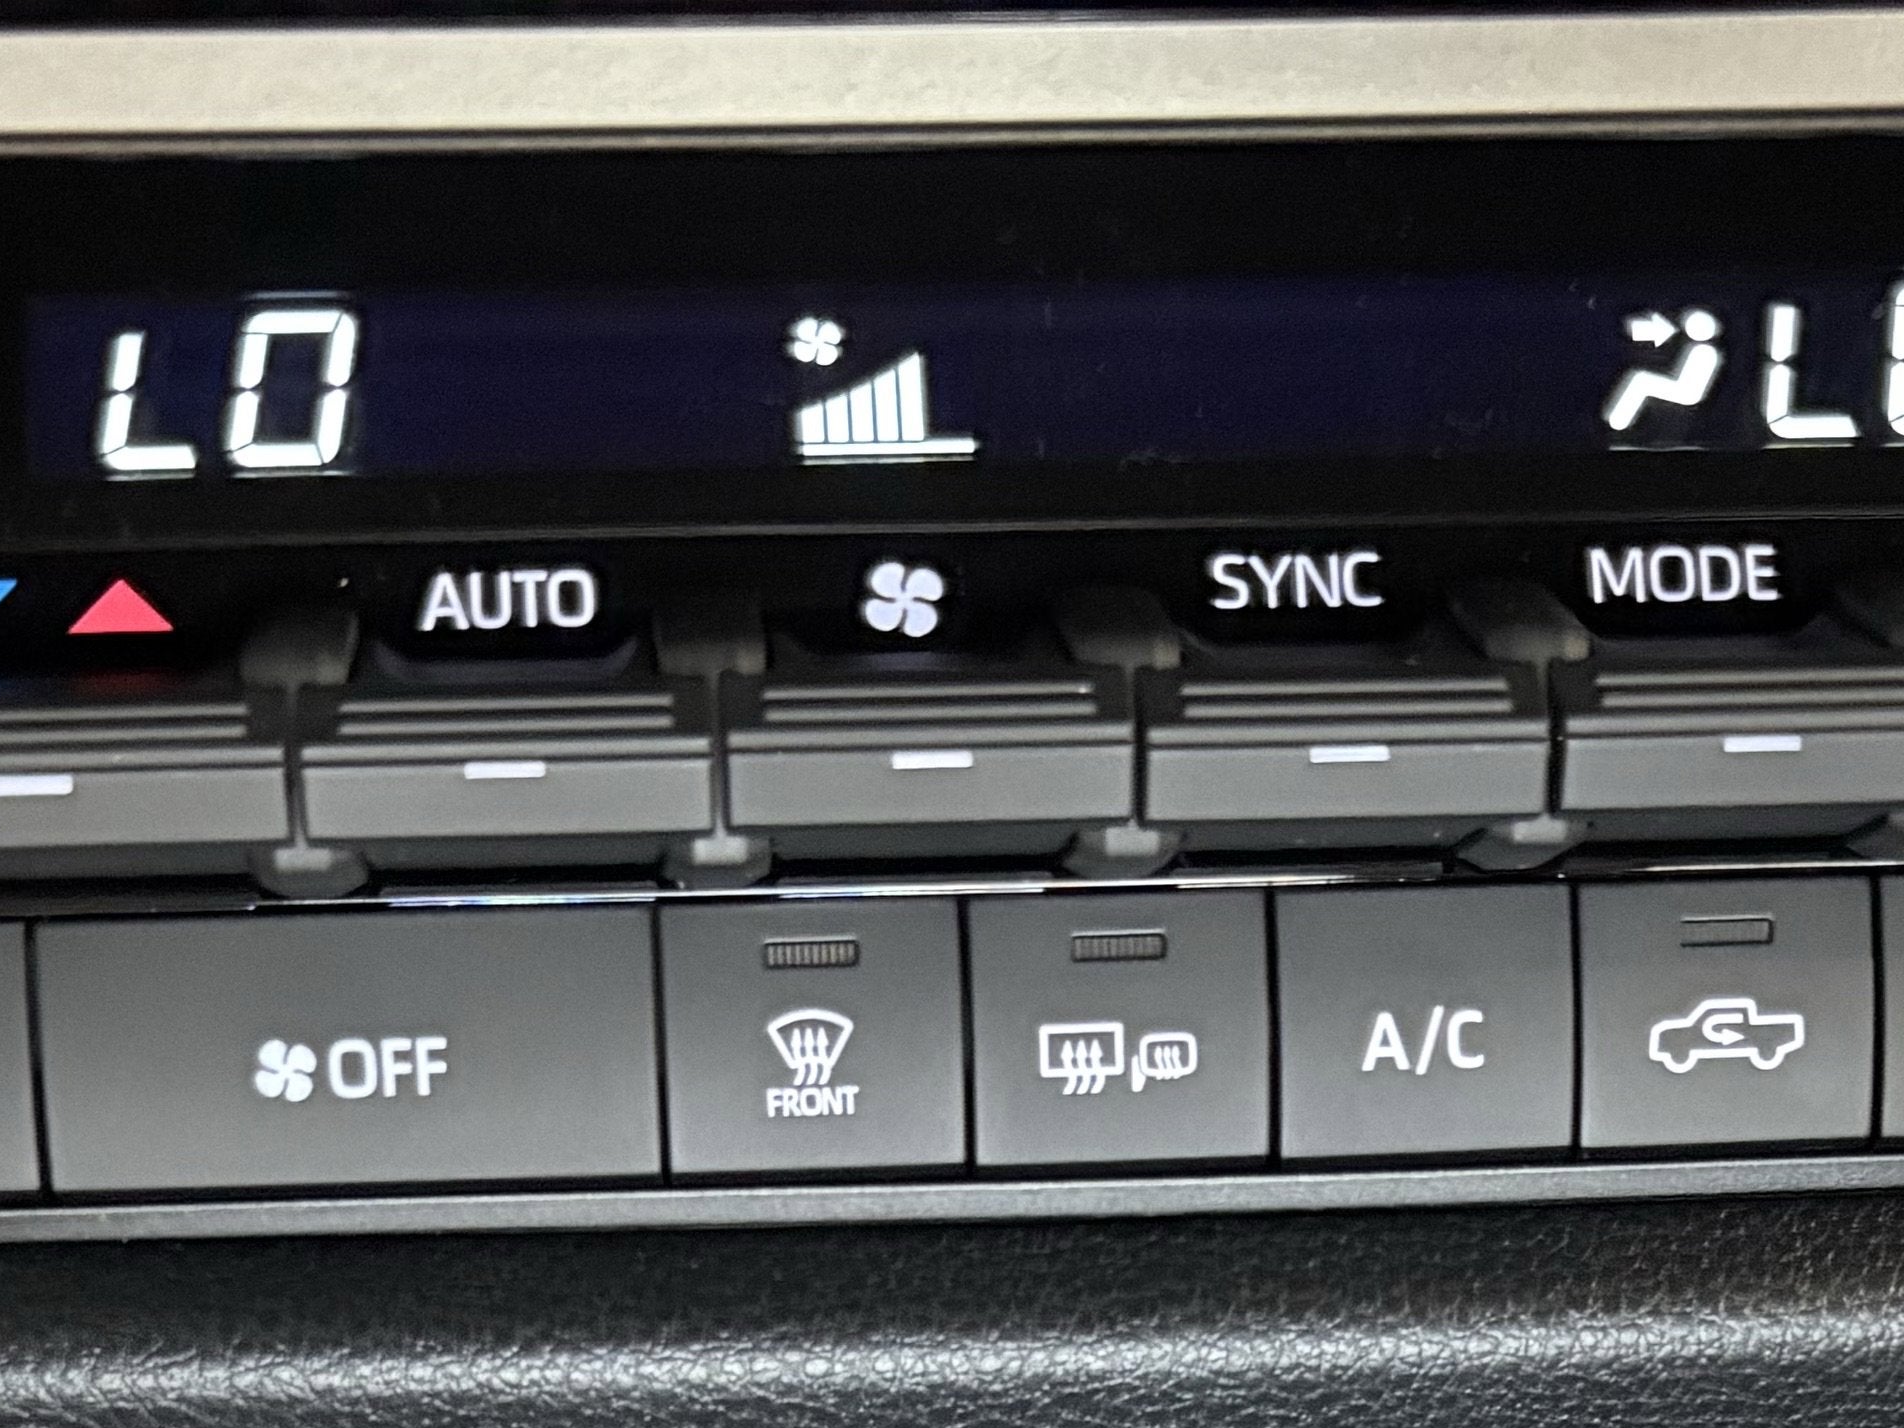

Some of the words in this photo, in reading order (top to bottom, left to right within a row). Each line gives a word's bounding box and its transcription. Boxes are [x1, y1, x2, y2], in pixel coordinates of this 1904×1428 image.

[98, 308, 358, 474] LO
[418, 566, 598, 633] AUTO
[1204, 549, 1384, 612] SYNC
[1586, 542, 1782, 605] MODE
[326, 1034, 450, 1101] OFF
[1360, 1004, 1487, 1076] A/C
[764, 1084, 861, 1119] FRONT
